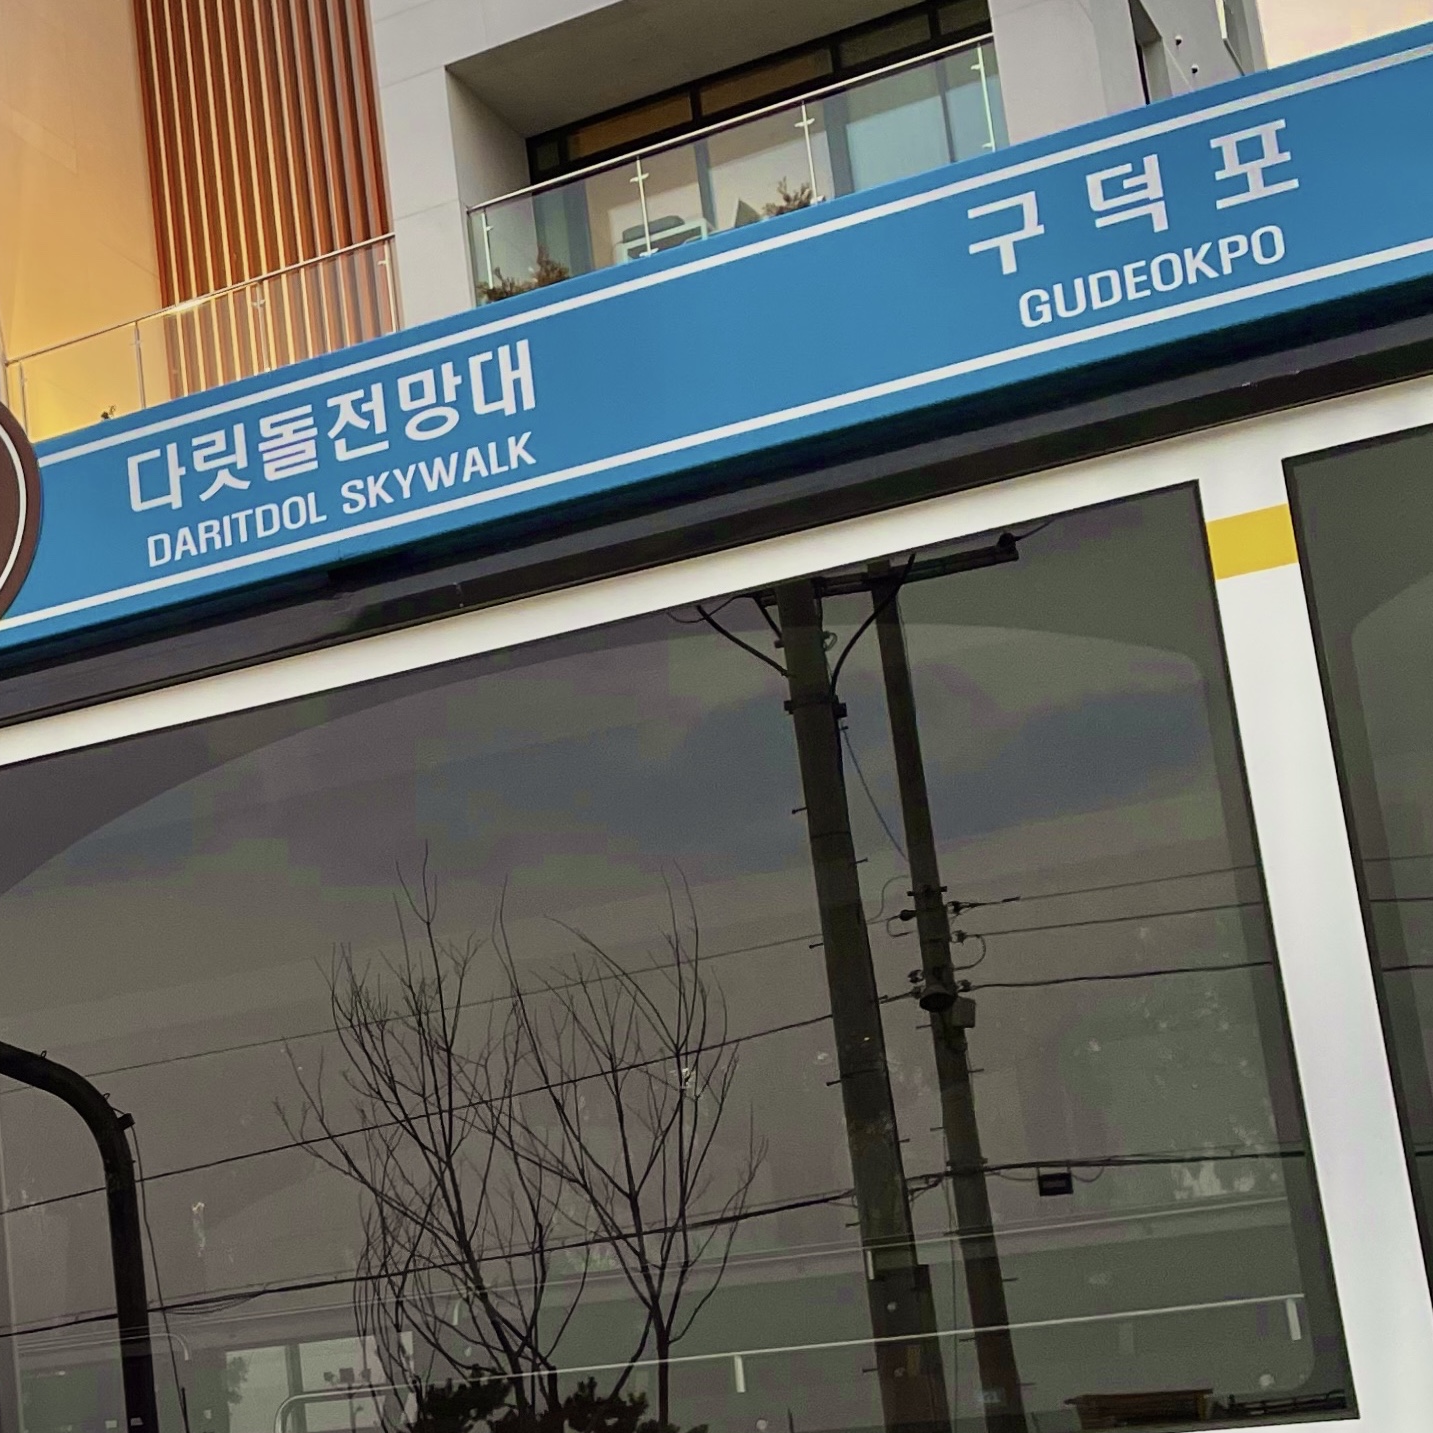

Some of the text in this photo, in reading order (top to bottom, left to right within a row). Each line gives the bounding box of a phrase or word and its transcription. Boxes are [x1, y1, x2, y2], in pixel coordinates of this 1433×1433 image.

[1018, 224, 1287, 329] GUDEOKPO
[126, 338, 537, 513] 다릿돌전망대
[146, 431, 537, 569] DARITDOL SKYWALK
